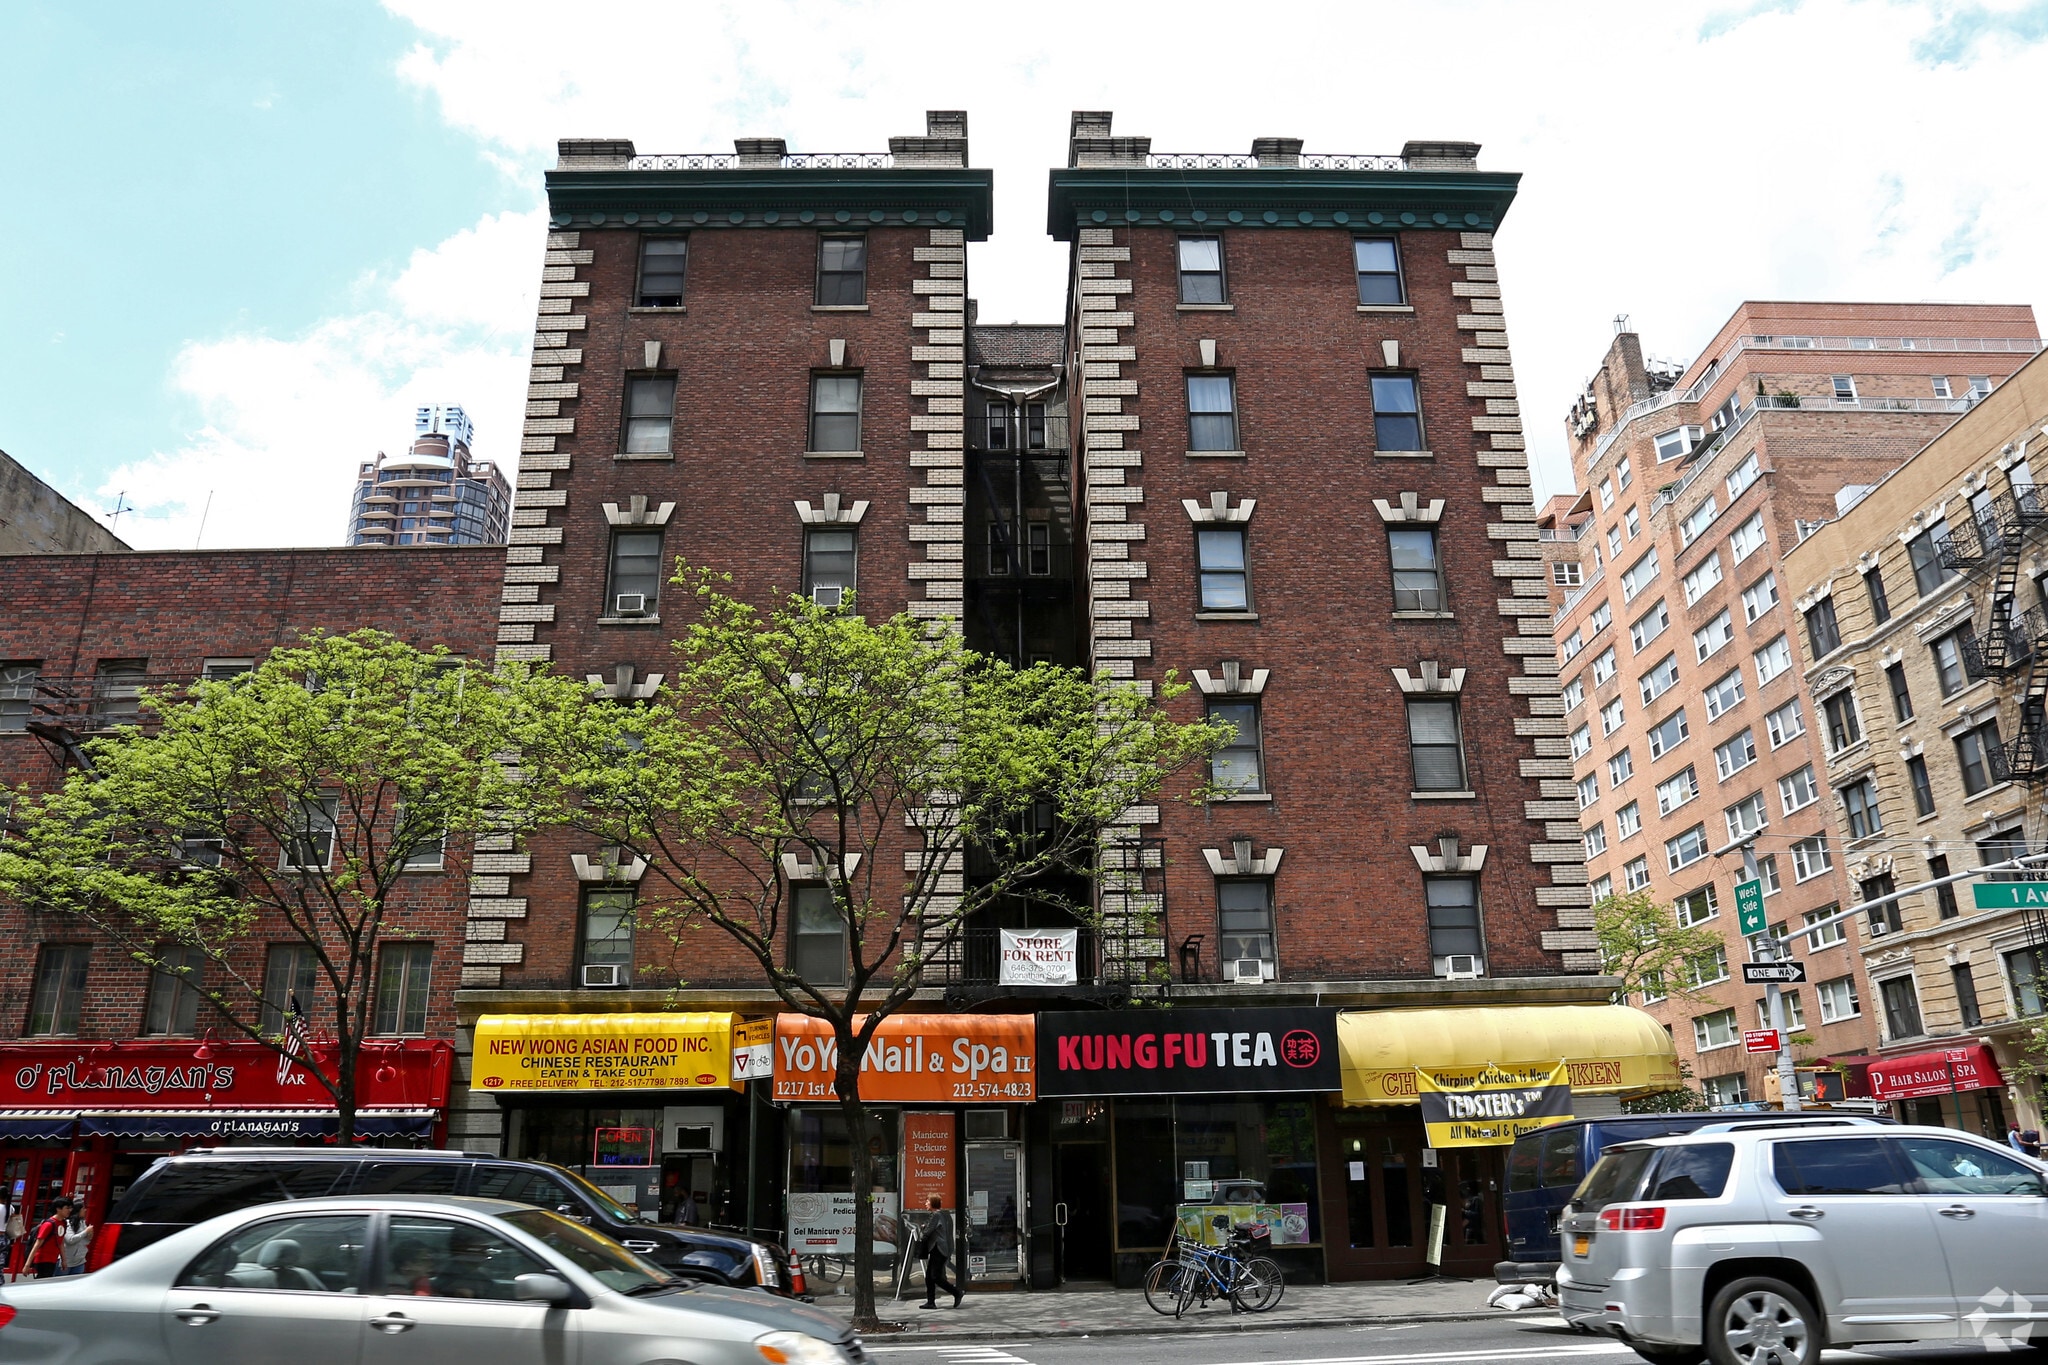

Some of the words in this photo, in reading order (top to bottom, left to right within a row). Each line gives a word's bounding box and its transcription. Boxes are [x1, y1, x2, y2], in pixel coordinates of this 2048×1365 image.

[1739, 885, 1757, 900] West
[2011, 888, 2019, 903] 1
[1743, 901, 1757, 913] Side
[1016, 938, 1062, 949] STORE
[1003, 950, 1031, 961] FOR
[1036, 950, 1073, 961] RENT
[1752, 969, 1770, 978] ONE
[1777, 969, 1795, 977] WAY
[750, 1024, 768, 1032] TURNING
[490, 1039, 525, 1055] NEW
[529, 1039, 578, 1054] WONG
[581, 1038, 628, 1054] ASIAN
[634, 1037, 678, 1053] FOOD
[682, 1036, 713, 1052] INC.
[1058, 1034, 1158, 1070] KUNG
[1164, 1033, 1207, 1068] FU
[1210, 1032, 1278, 1067] TEA
[1298, 1038, 1314, 1060] 茶
[521, 1056, 581, 1068] CHINESE
[585, 1055, 678, 1068] RESTAURANT
[860, 1036, 922, 1073] Nail
[928, 1052, 944, 1072] &
[951, 1037, 1008, 1081] Spa
[1014, 1056, 1031, 1073] II
[286, 1073, 306, 1085] AR
[540, 1069, 565, 1078] EAT
[567, 1070, 578, 1078] IN
[582, 1069, 590, 1077] &
[593, 1069, 626, 1077] TAKE
[629, 1068, 655, 1076] OUT
[1434, 1074, 1475, 1088] Chirping
[1478, 1070, 1516, 1084] Chicken
[1519, 1070, 1526, 1082] is
[1530, 1068, 1550, 1081] Now
[484, 1078, 503, 1086] 1217
[510, 1080, 533, 1088] FREE
[536, 1079, 579, 1088] DELIVERY
[589, 1079, 608, 1087] TEL:
[669, 1078, 689, 1086] 7898
[777, 1081, 804, 1095] 1217
[808, 1081, 825, 1095] 1st
[828, 1082, 837, 1095] A
[953, 1083, 1031, 1097] 212-574-4823
[1871, 1072, 1883, 1095] P
[1065, 1103, 1083, 1116] EXIT
[606, 1131, 642, 1143] OPEN
[912, 1130, 948, 1139] Manicure
[1450, 1125, 1461, 1139] All
[1465, 1124, 1500, 1138] Natural
[1503, 1124, 1510, 1136] &
[914, 1143, 947, 1152] Pedicure
[916, 1156, 945, 1166] Waxing
[915, 1168, 946, 1179] Massage
[794, 1227, 805, 1235] Gel
